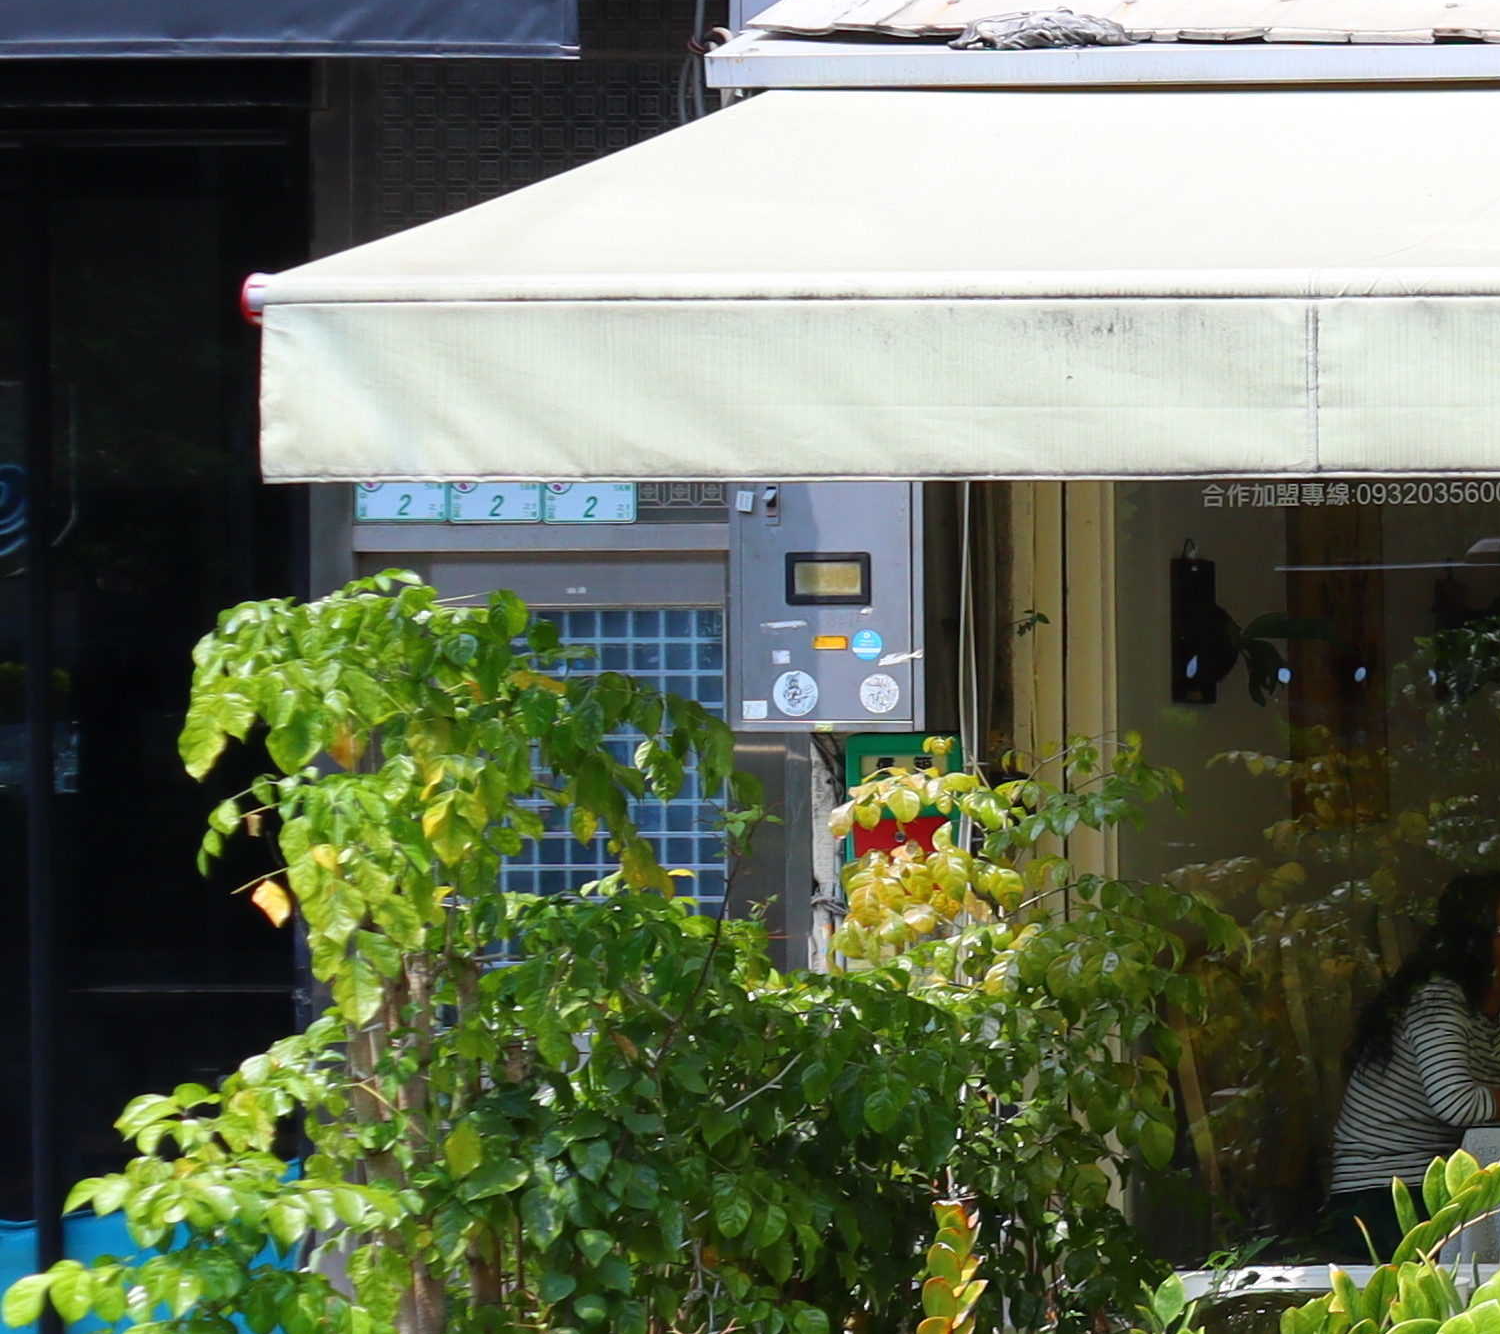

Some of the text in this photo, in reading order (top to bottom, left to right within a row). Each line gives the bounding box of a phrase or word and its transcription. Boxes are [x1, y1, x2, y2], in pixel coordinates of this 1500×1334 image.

[397, 494, 412, 516] 2
[489, 495, 504, 517] 2
[583, 496, 598, 518] 2
